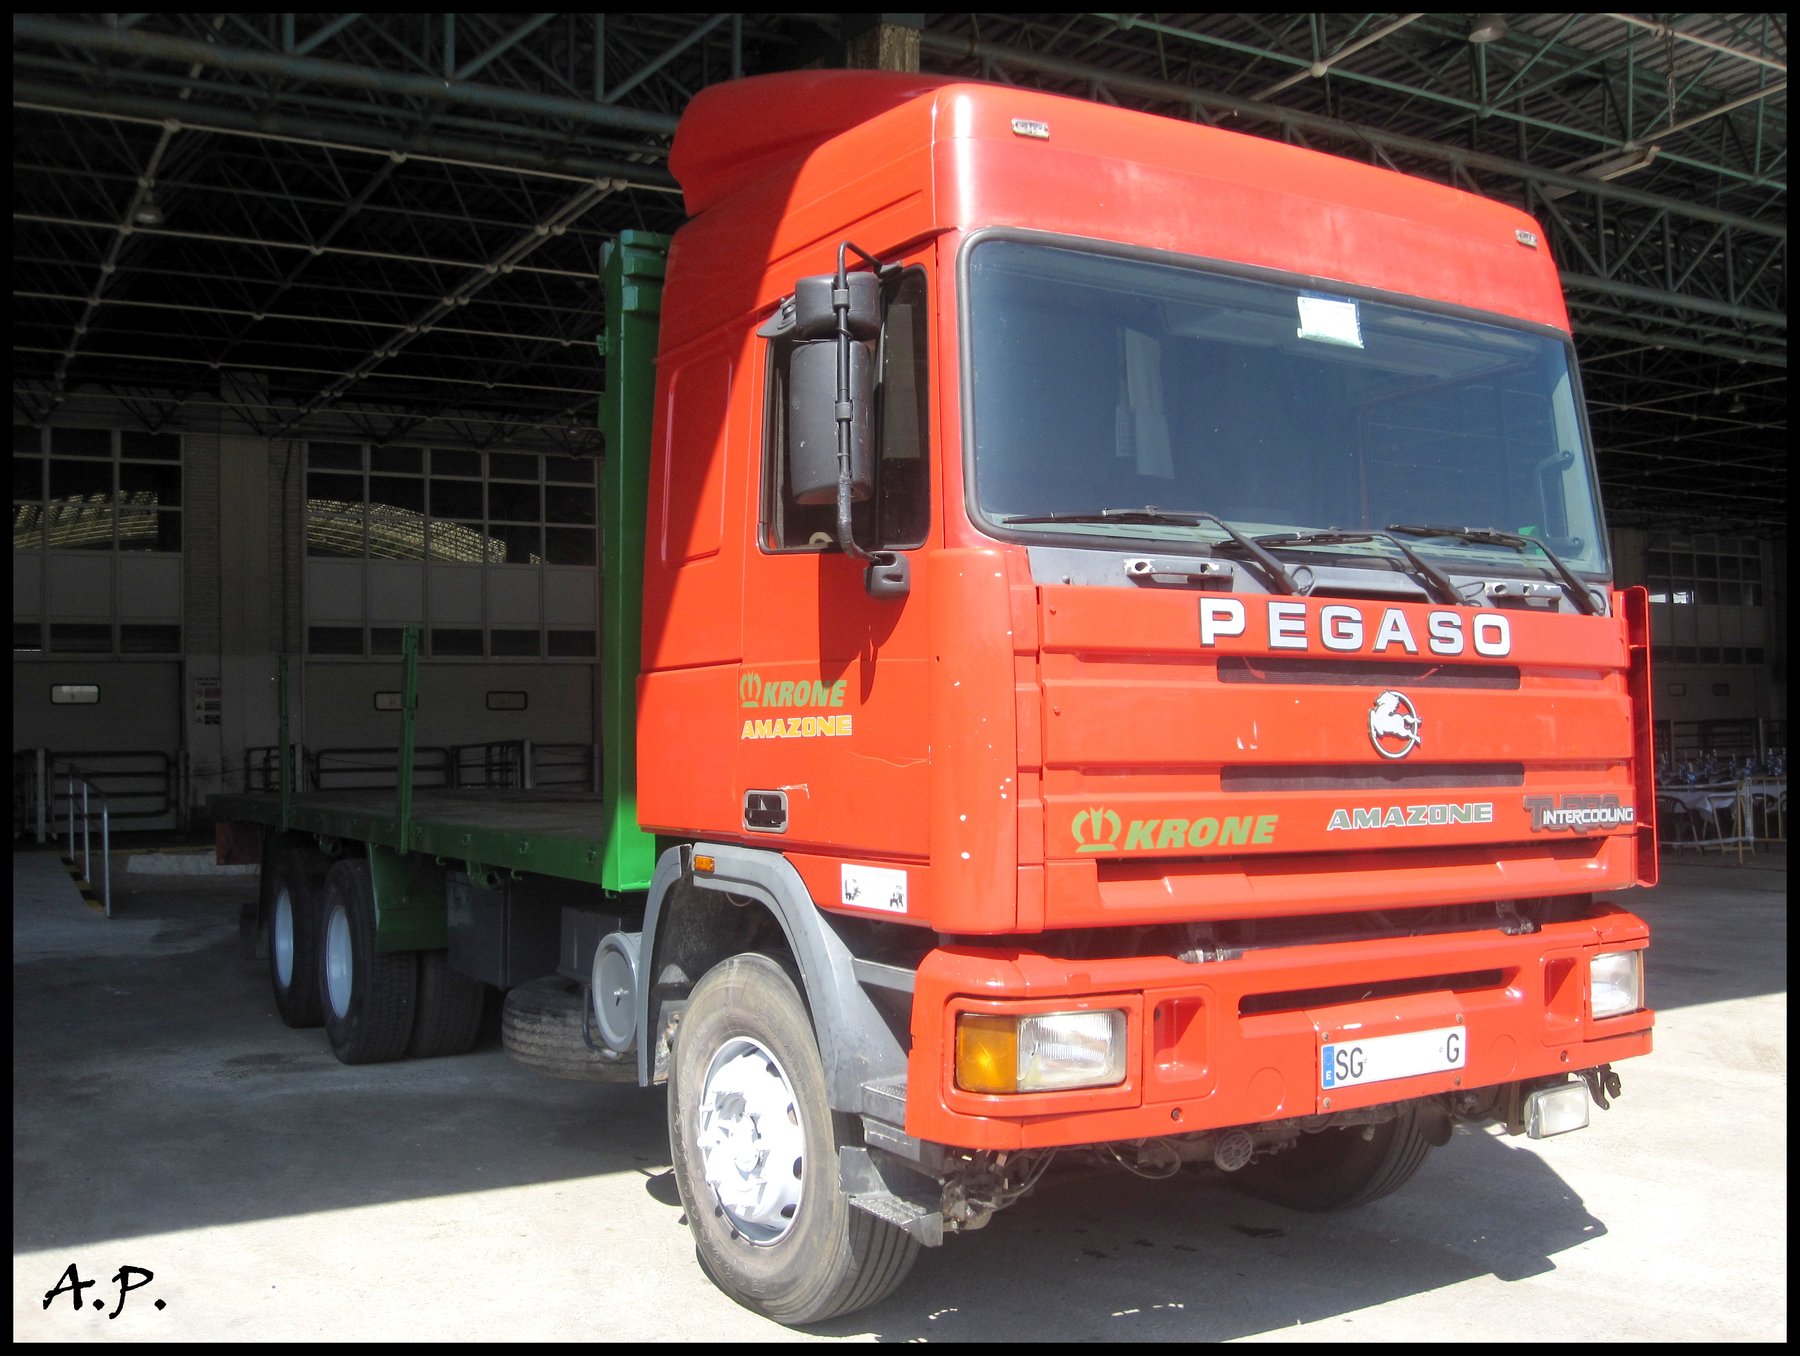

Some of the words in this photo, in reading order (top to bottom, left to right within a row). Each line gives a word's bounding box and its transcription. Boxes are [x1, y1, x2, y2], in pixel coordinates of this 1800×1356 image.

[1199, 597, 1511, 657] PEGASO
[762, 679, 848, 707] KRONE
[741, 714, 853, 739] AMAZONE
[1326, 802, 1493, 831] AMAZONE
[1543, 807, 1634, 825] INTERCOOLING
[1123, 814, 1279, 851] KRONE
[1446, 1033, 1460, 1063] G
[1325, 1070, 1332, 1080] E
